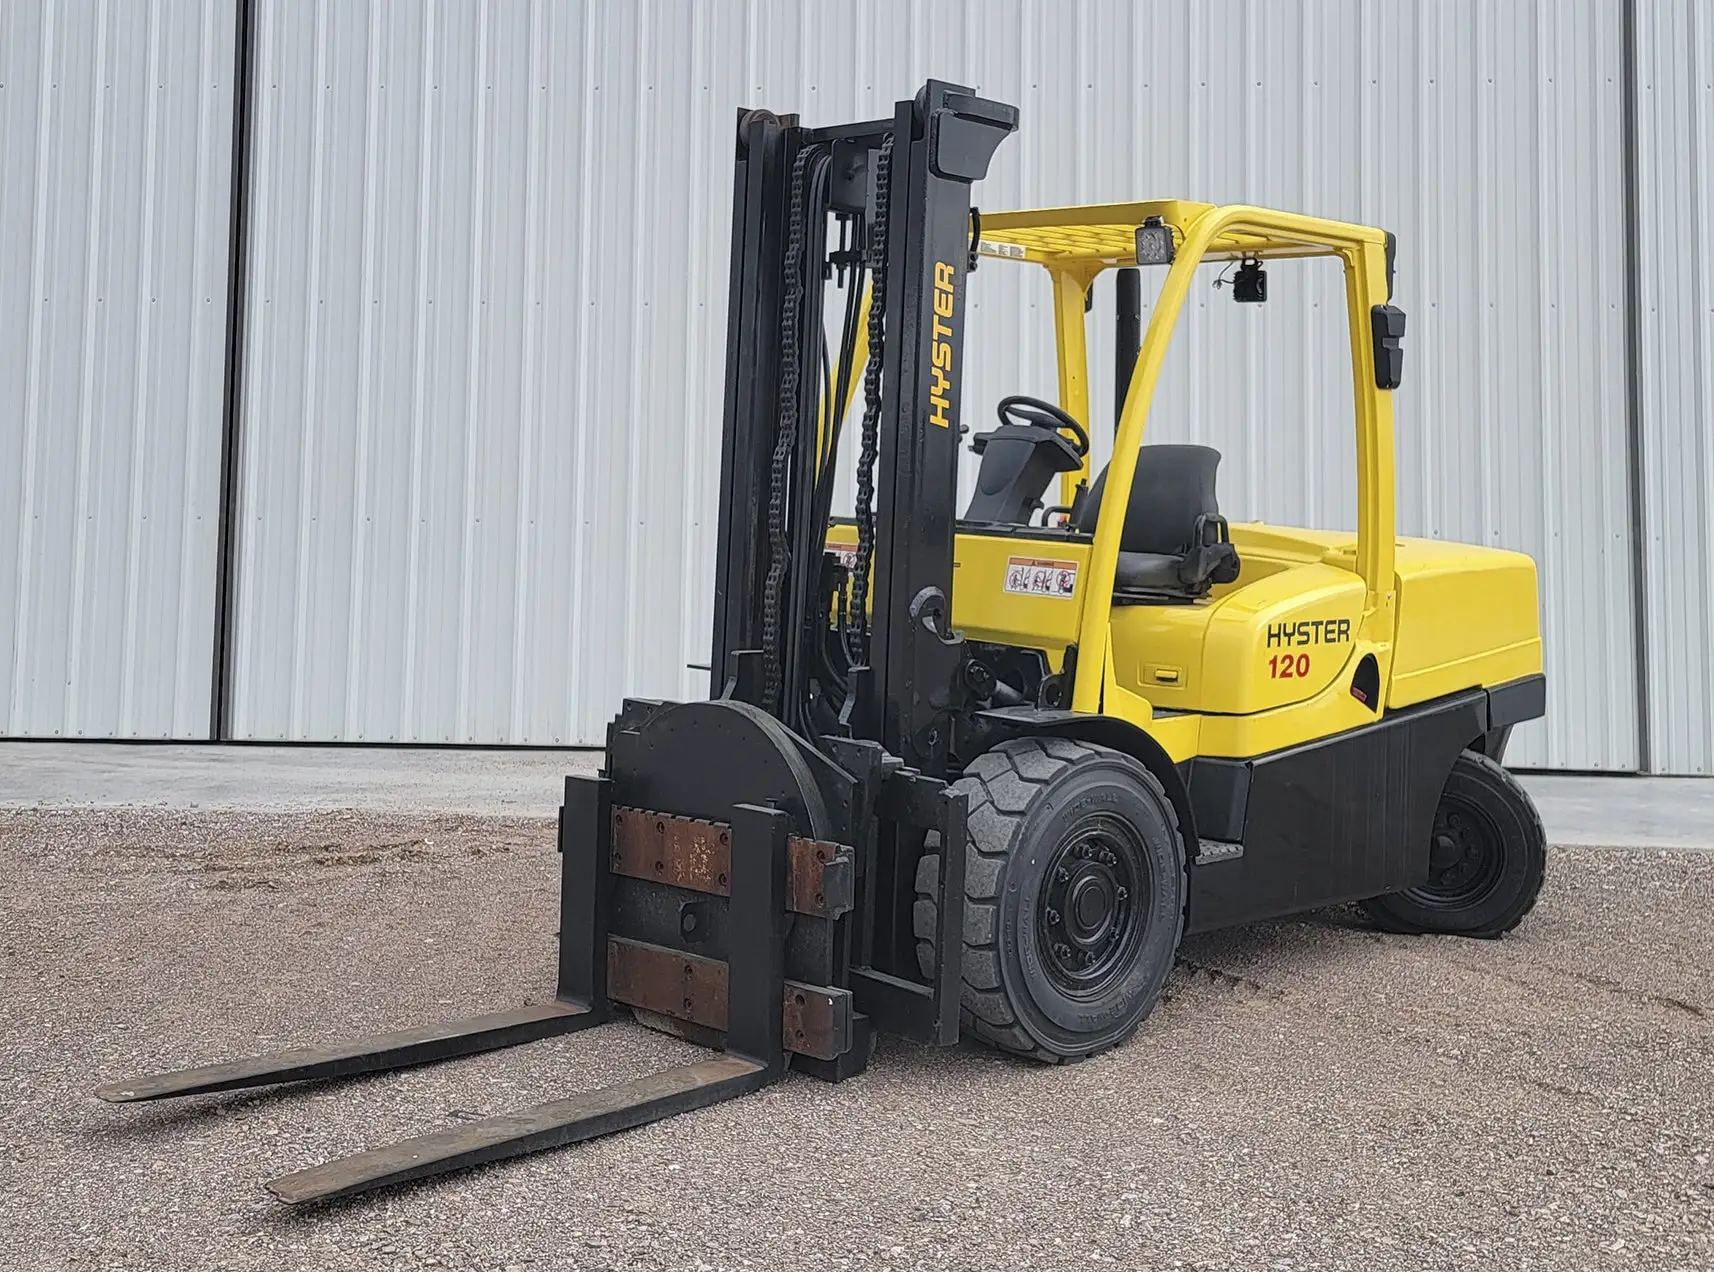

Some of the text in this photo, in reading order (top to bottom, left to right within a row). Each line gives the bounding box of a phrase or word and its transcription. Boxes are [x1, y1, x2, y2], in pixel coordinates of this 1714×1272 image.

[929, 261, 955, 428] HYSTER
[1266, 618, 1351, 648] HYSTER
[1268, 653, 1311, 679] 120
